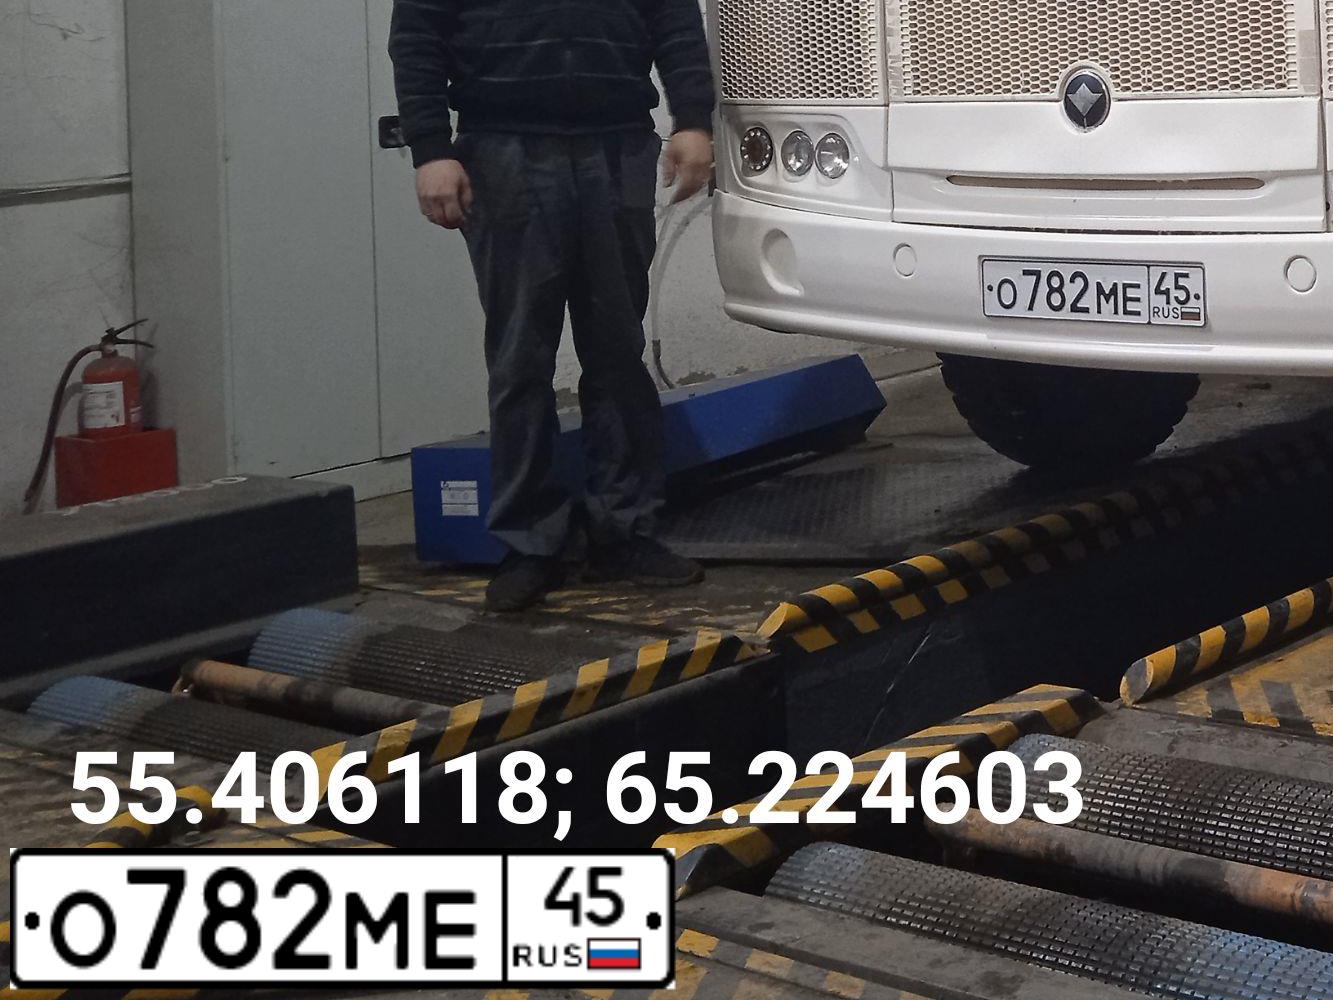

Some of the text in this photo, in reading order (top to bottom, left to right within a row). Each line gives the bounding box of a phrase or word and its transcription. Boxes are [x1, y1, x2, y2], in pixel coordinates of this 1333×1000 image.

[996, 268, 1191, 317] О782МЕ 45
[1151, 305, 1180, 320] RUS
